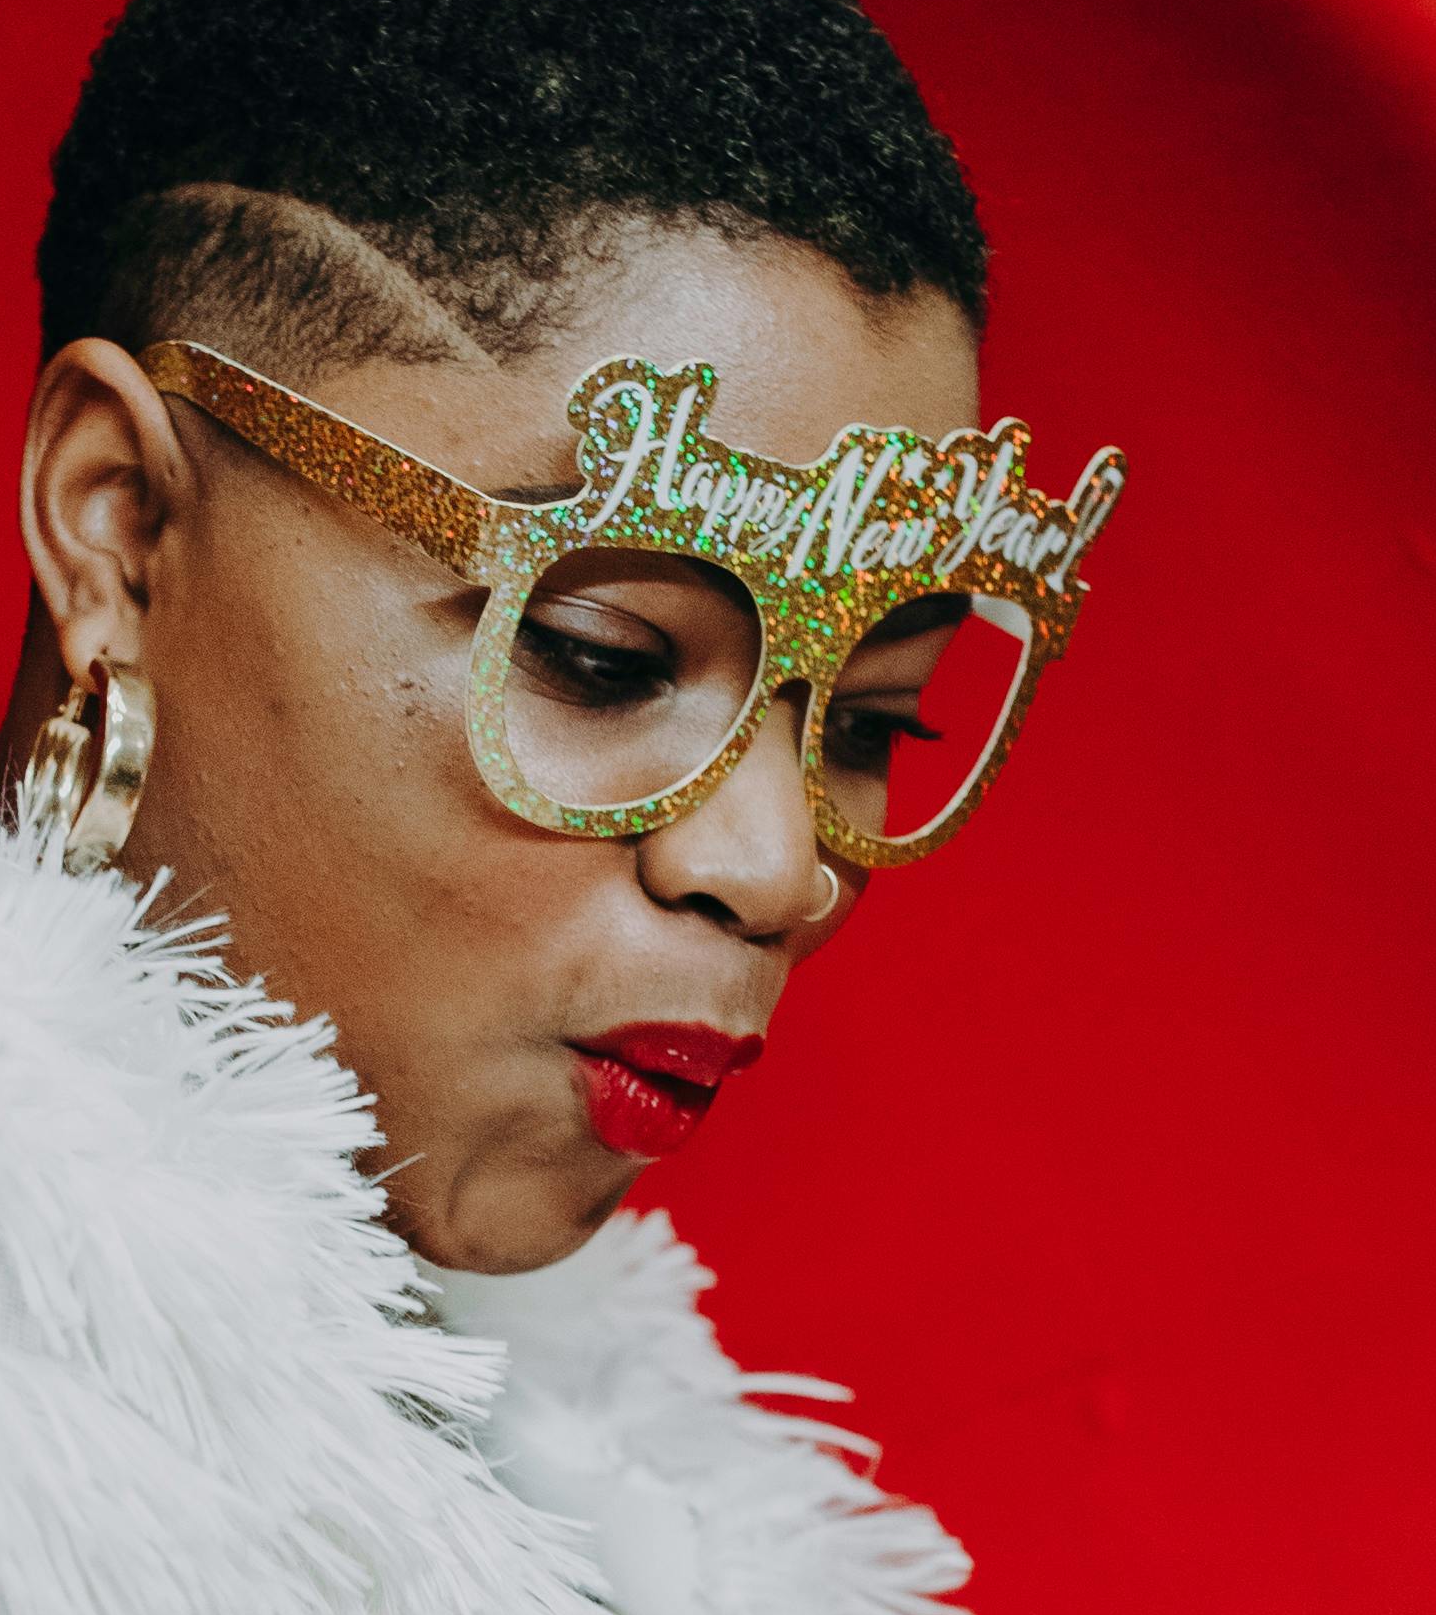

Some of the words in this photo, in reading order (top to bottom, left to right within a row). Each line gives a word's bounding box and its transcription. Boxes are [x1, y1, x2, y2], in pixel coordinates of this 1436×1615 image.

[576, 380, 805, 556] Happy
[784, 443, 938, 579] New
[932, 440, 1125, 594] Year!
